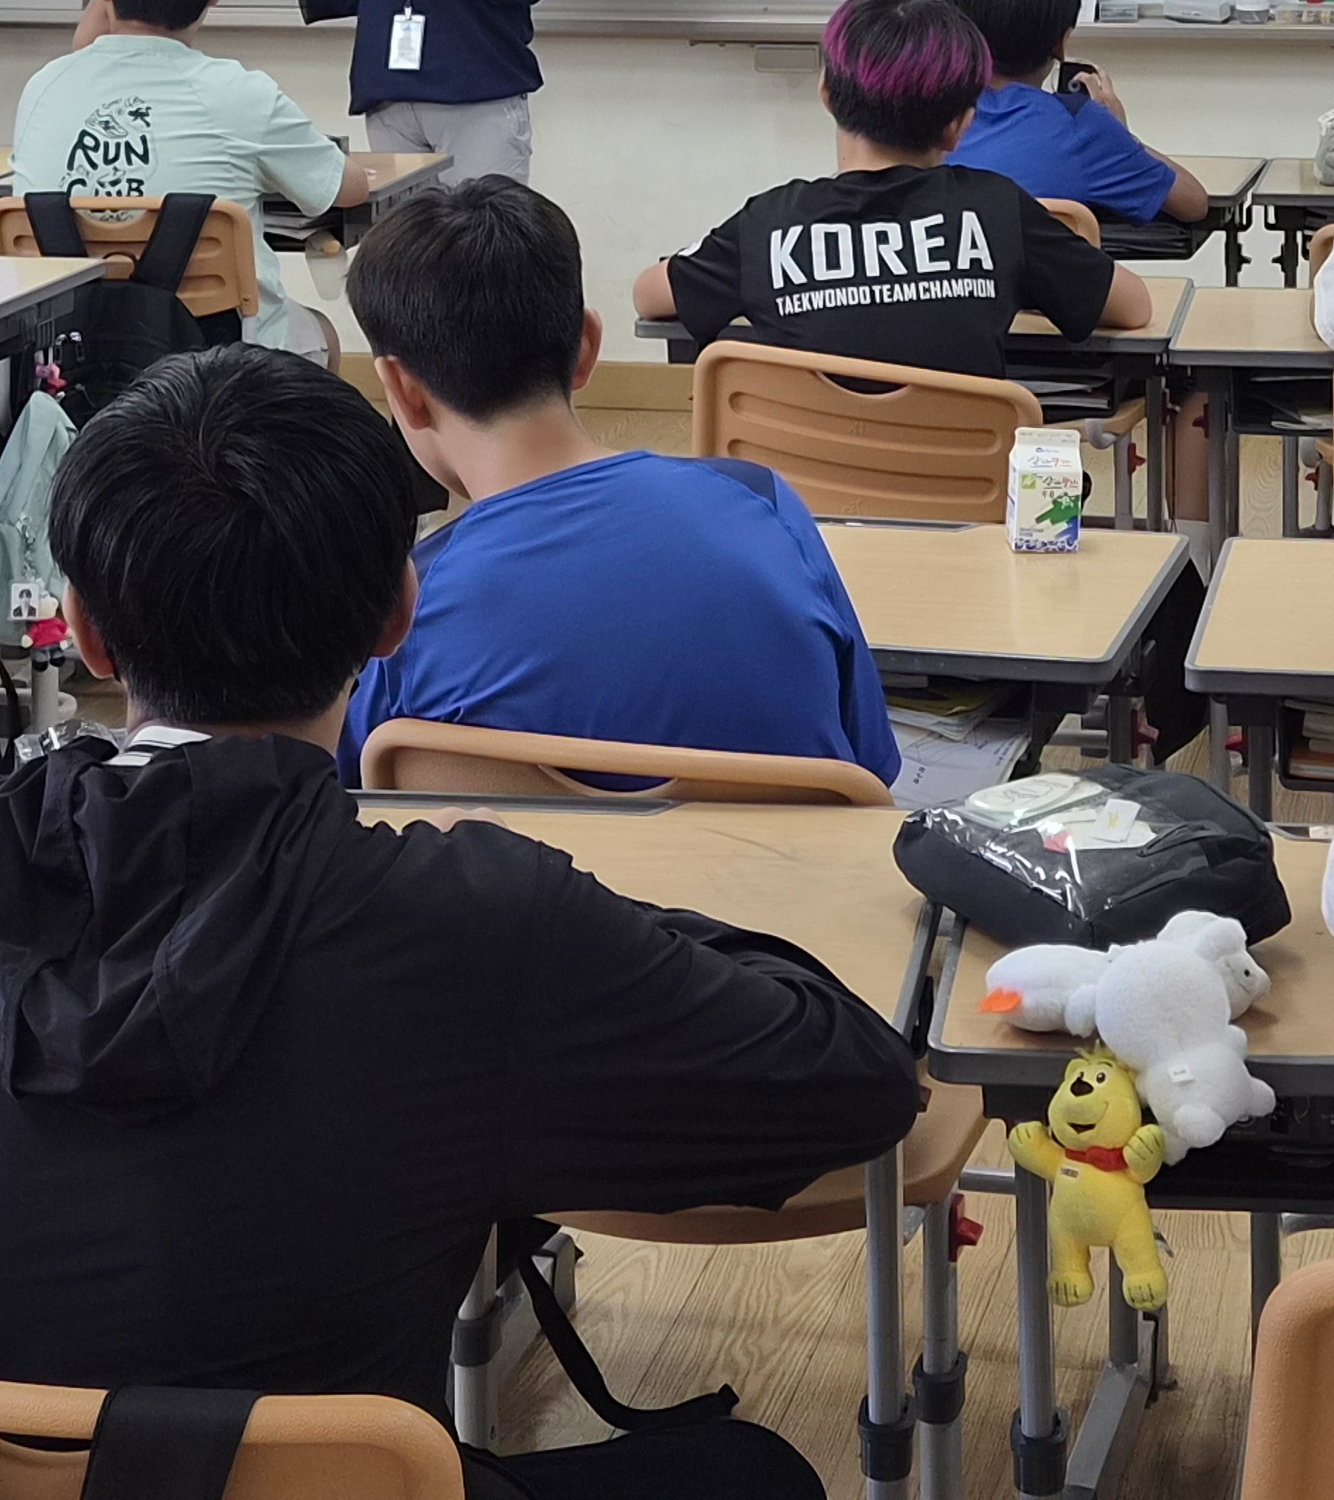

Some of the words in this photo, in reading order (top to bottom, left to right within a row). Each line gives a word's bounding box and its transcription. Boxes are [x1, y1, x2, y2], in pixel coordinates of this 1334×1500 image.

[67, 129, 150, 172] RUN
[769, 210, 994, 289] KOREA
[776, 285, 871, 317] TAEKWONDO
[873, 280, 918, 304] TEAM
[919, 279, 995, 301] CHAMPION
